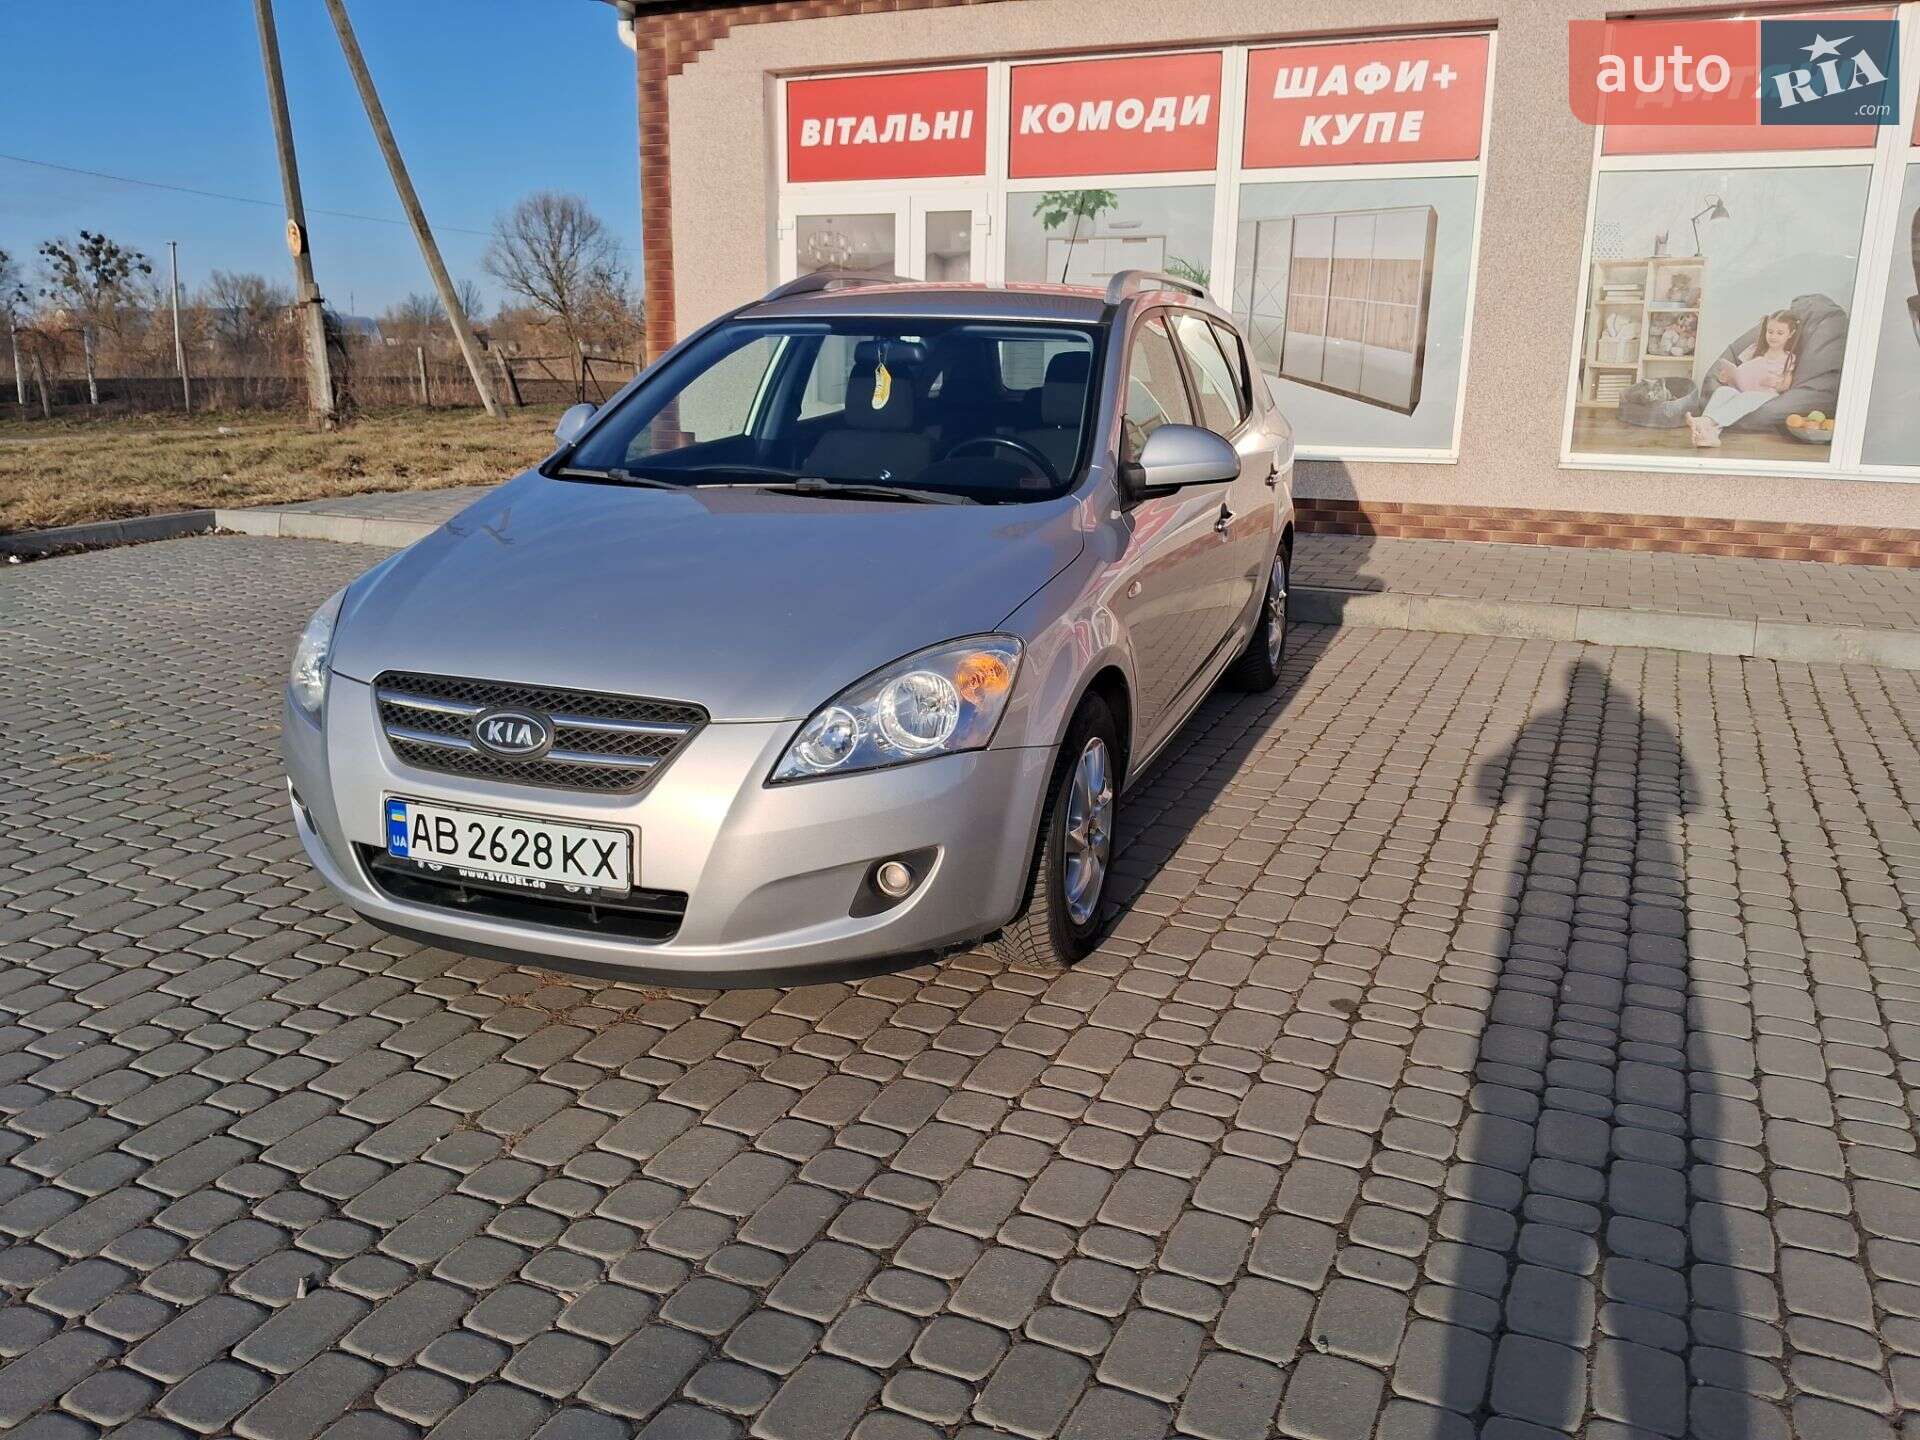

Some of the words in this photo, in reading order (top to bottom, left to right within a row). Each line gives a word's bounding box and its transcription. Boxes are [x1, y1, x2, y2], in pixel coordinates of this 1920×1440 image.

[1273, 60, 1457, 99] ШАФИ+
[800, 109, 974, 148] ВІТАЛЬНІ
[1019, 95, 1211, 135] КОМОДИ
[1299, 110, 1424, 147] КУПЕ
[487, 720, 533, 746] KIA
[393, 834, 407, 848] UA
[412, 814, 459, 855] AB
[468, 823, 553, 870] 2628
[562, 835, 618, 880] KX
